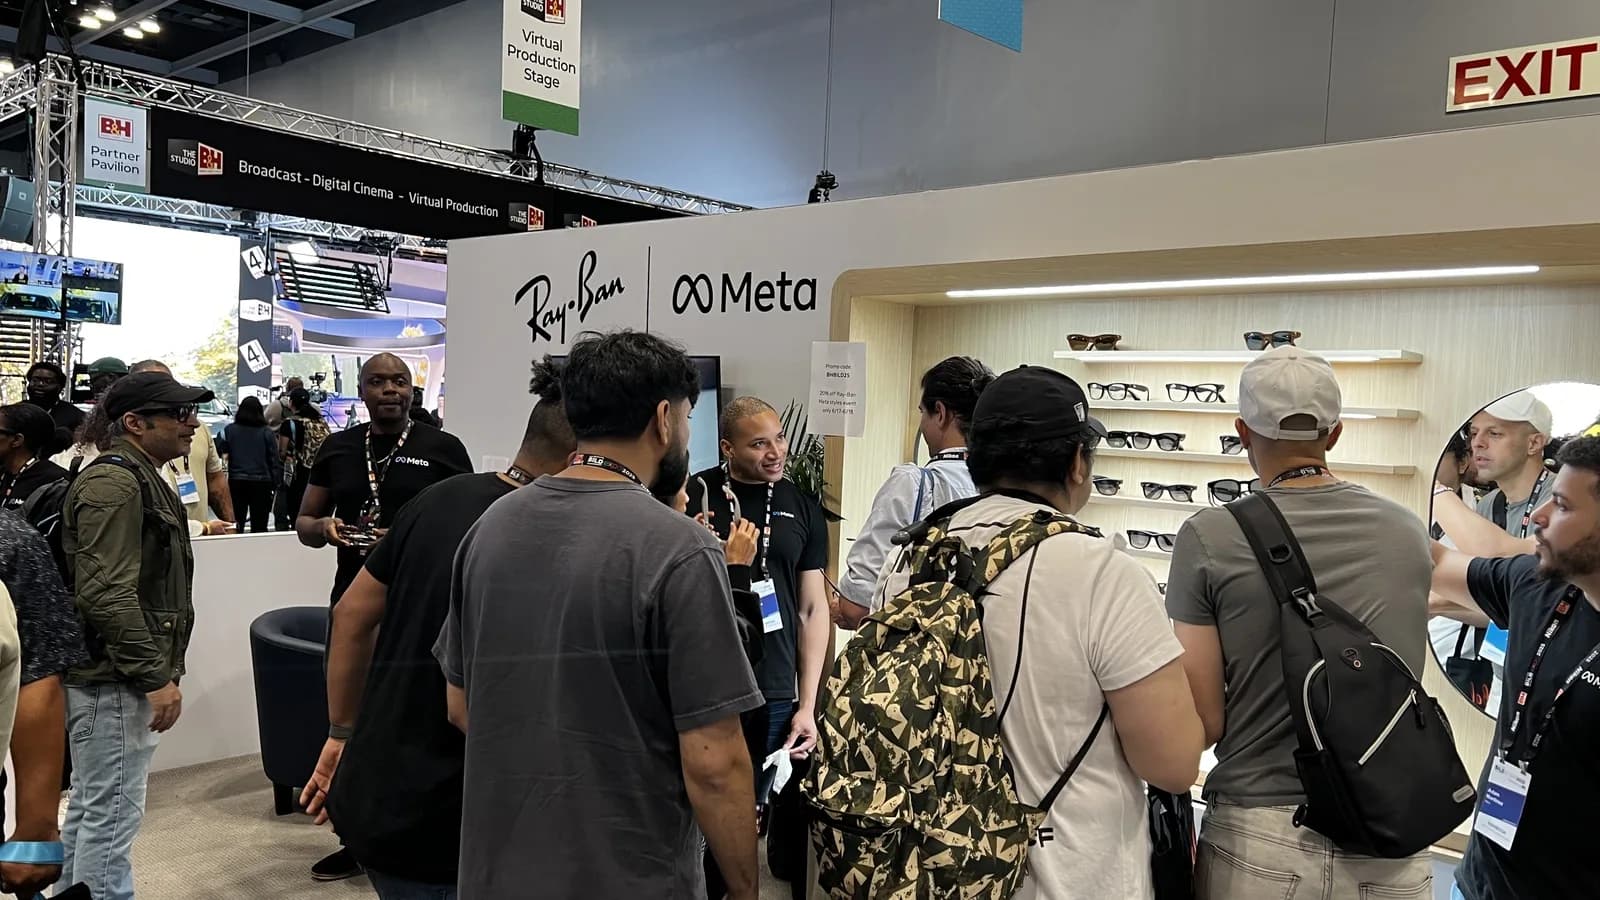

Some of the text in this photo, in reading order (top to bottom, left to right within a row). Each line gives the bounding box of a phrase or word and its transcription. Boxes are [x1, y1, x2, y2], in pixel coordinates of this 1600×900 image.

[522, 29, 563, 52] Virtual
[508, 44, 576, 74] Production
[524, 68, 560, 89] Stage
[1453, 43, 1598, 105] EXIT
[100, 117, 131, 137] B&H
[91, 145, 140, 161] Partner
[170, 146, 222, 169] STUDIO B&H
[182, 149, 197, 159] THE
[91, 159, 140, 174] Pavilion
[239, 160, 302, 183] Broadcast
[312, 174, 351, 191] Digital
[353, 181, 394, 200] Cinema
[408, 191, 444, 209] Virtual
[446, 199, 499, 218] Production
[510, 206, 544, 226] STUDIO B&H
[518, 210, 528, 218] THE
[249, 250, 262, 270] 4
[721, 271, 818, 313] Meta
[247, 344, 260, 363] 4
[407, 456, 429, 467] Meta
